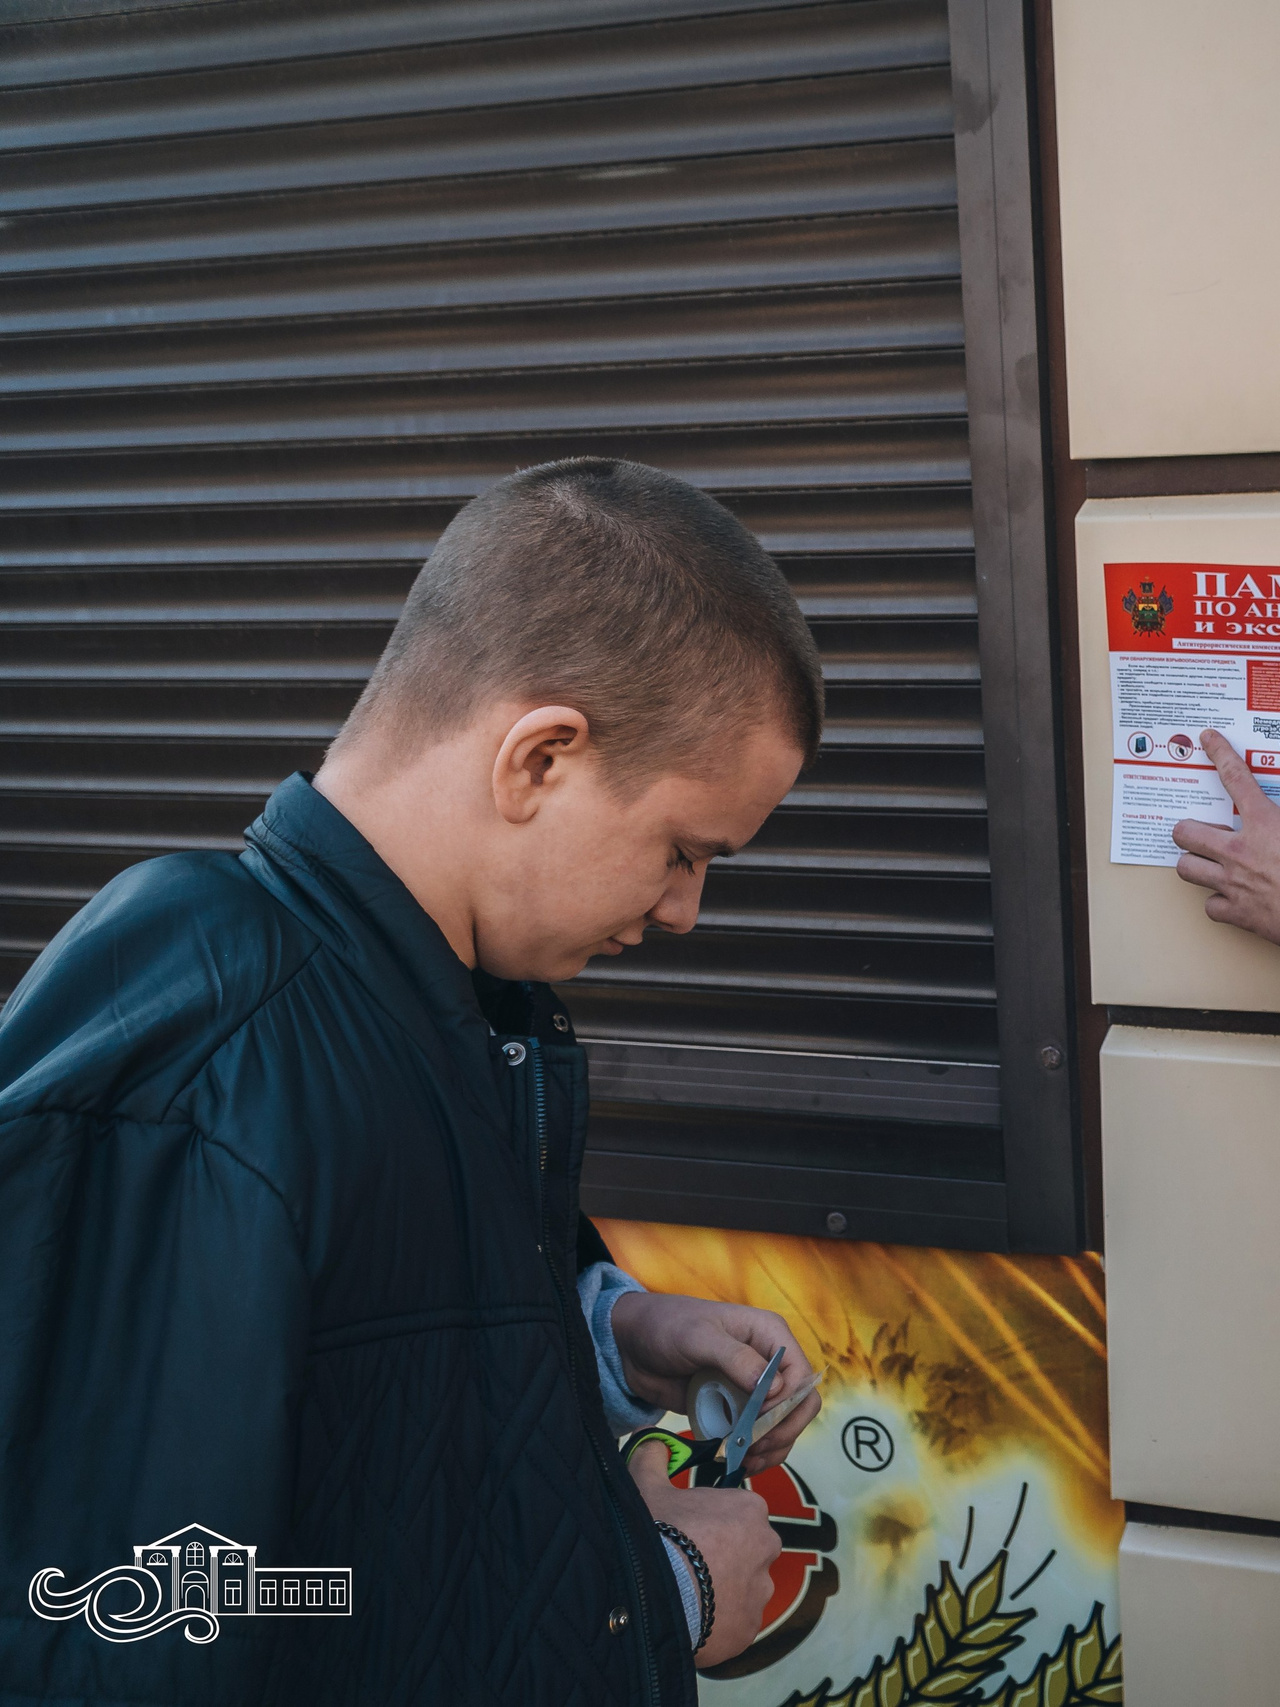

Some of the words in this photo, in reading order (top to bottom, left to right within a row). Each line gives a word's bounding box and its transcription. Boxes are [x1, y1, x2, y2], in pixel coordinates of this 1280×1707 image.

[1194, 600, 1237, 616] ПО
[1194, 621, 1215, 634] и
[1177, 641, 1250, 650] Антитеррористическая
[1260, 755, 1275, 766] 02
